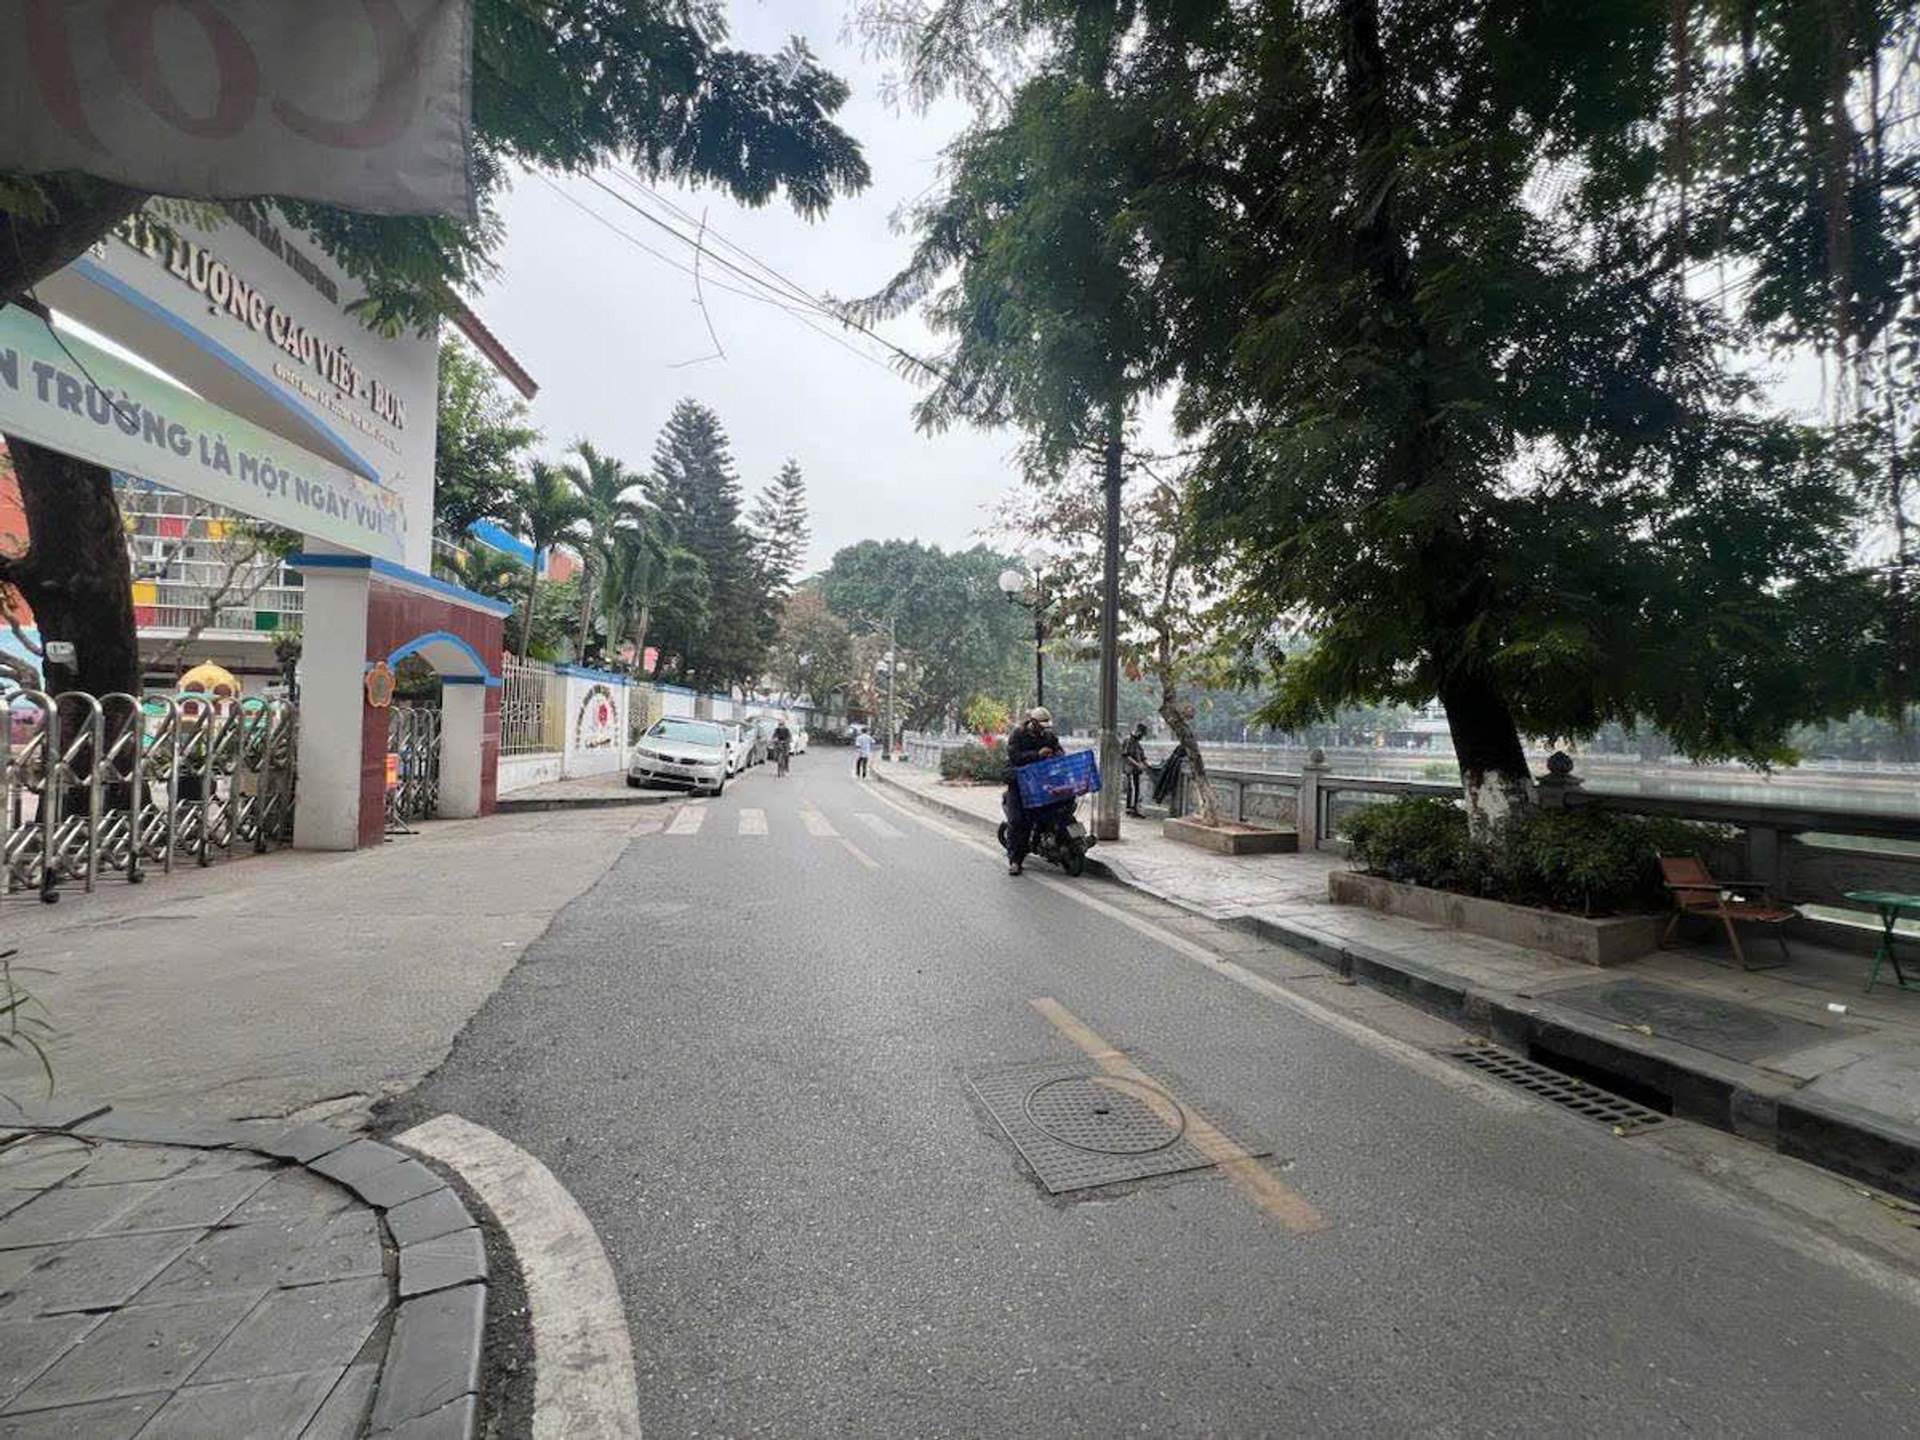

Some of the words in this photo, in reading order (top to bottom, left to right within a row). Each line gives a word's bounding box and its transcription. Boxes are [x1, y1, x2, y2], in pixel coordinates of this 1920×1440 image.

[268, 306, 315, 367] CAO
[31, 360, 193, 457] TRƯỜNG
[198, 433, 232, 476] LÀ
[238, 450, 290, 498] MỘT
[295, 475, 351, 521] NGÀY
[354, 498, 383, 535] VUI
